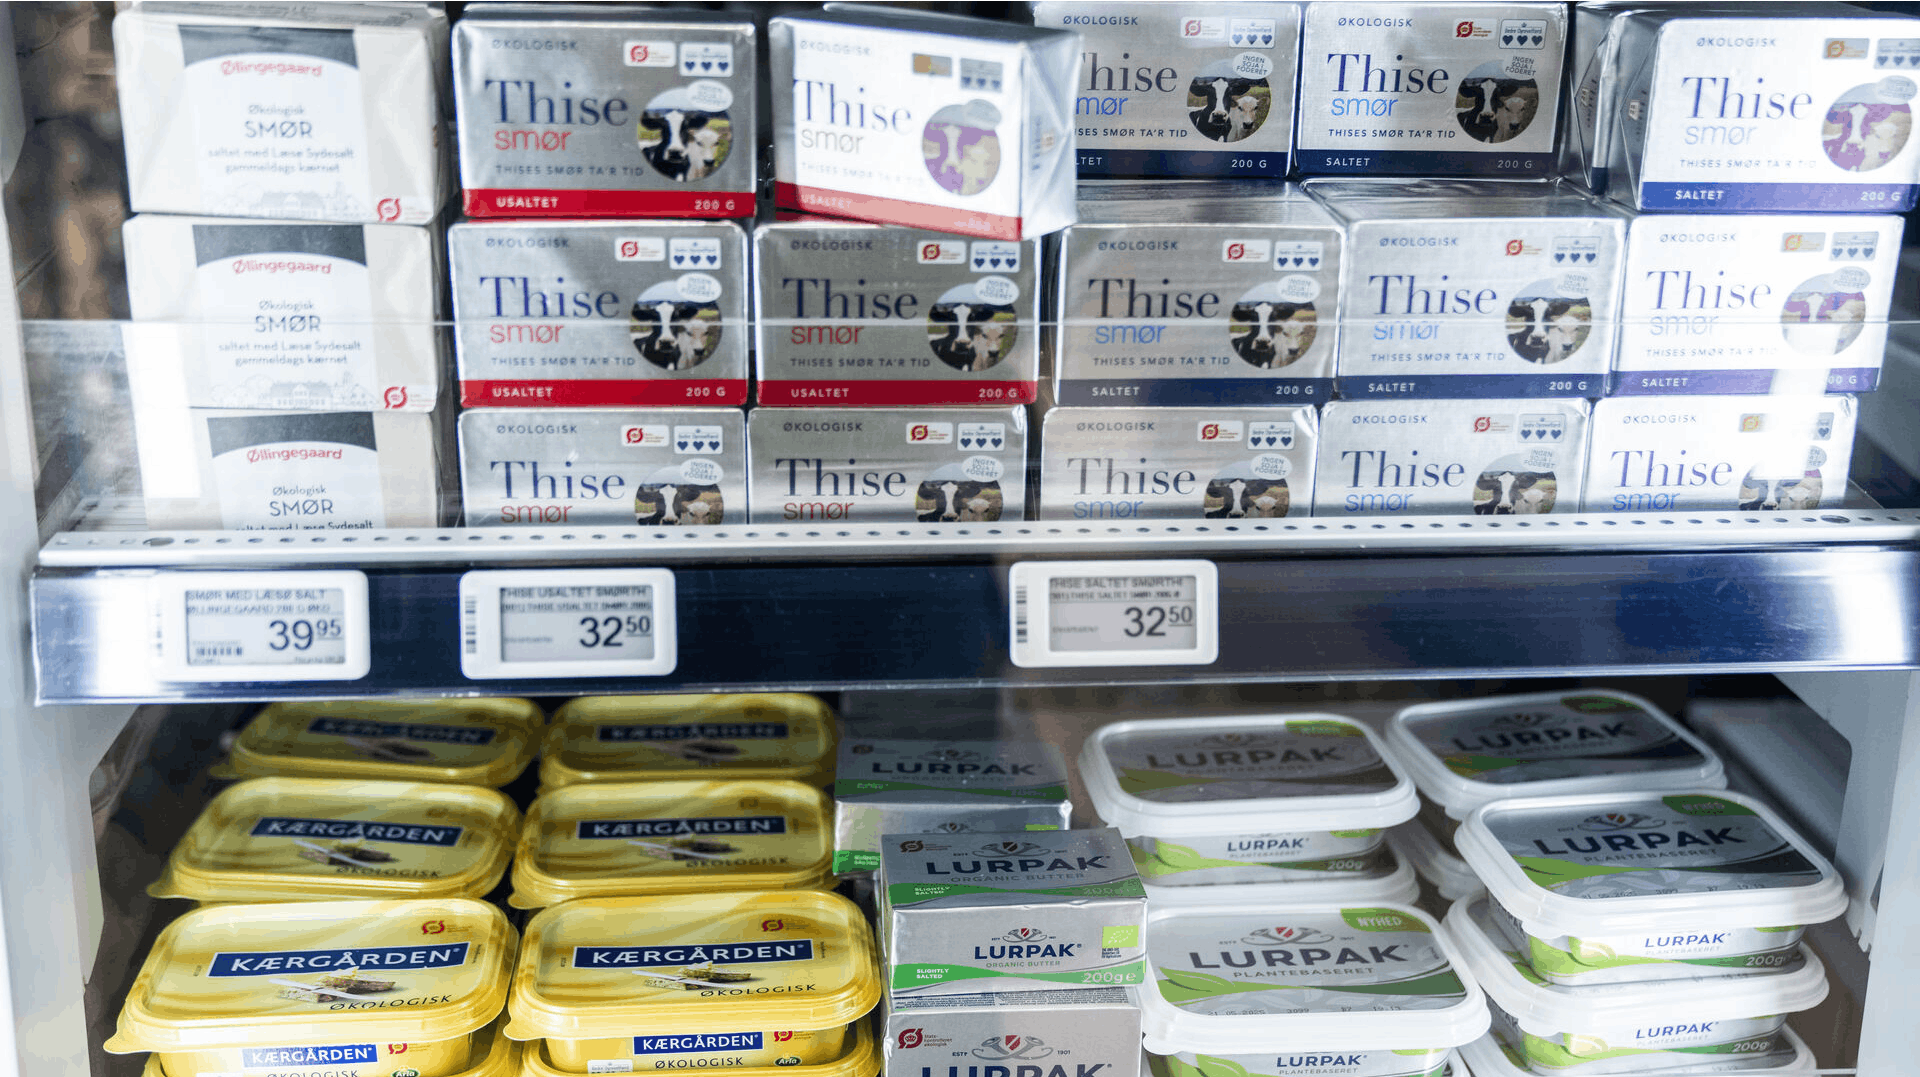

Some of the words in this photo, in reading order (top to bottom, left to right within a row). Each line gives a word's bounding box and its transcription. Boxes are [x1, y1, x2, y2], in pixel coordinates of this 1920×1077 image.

[1063, 16, 1138, 25] ØKOLOGISK
[1338, 18, 1412, 27] ØKOLOGISK
[492, 39, 577, 51] ØKOLOGISK
[1696, 37, 1776, 47] ØKOLOGISK
[1082, 53, 1177, 92] hise
[1328, 53, 1448, 93] Thise
[485, 80, 628, 126] Thise
[1076, 97, 1128, 115] mør
[1331, 97, 1398, 116] smør
[1681, 77, 1812, 120] Thise
[792, 80, 911, 134] Thise
[245, 121, 312, 138] SMØR
[1103, 129, 1134, 137] SMØR
[1329, 129, 1367, 137] THISES
[1372, 130, 1403, 138] SMØR
[1409, 130, 1432, 138] TA'R
[1684, 125, 1757, 146] smør
[495, 129, 571, 150] smør
[801, 128, 863, 154] smør
[1076, 157, 1102, 165] LTET
[1232, 160, 1253, 168] 200
[1260, 160, 1267, 168] G
[1326, 157, 1370, 166] SALTET
[1497, 160, 1519, 168] 200
[1525, 160, 1532, 169] G
[496, 197, 558, 208] USALTET
[694, 200, 719, 210] 200
[726, 200, 734, 210] G
[1675, 190, 1723, 201] SALTET
[791, 240, 873, 250] ØKOLOGISK
[1098, 241, 1178, 250] ØKOLOGISK
[1379, 237, 1458, 247] ØKOLOGISK
[1660, 233, 1736, 242] ØKOLOGISK
[480, 277, 619, 319] Thise
[1088, 278, 1219, 318] Thise
[1368, 275, 1497, 315] Thise
[1647, 271, 1771, 309] Thise
[783, 278, 918, 319] Thise
[255, 315, 320, 332] SMØR
[490, 323, 564, 344] smør
[791, 325, 864, 344] smør
[1095, 324, 1166, 344] smør
[492, 357, 535, 366] THISES
[541, 357, 576, 366] SMØR
[583, 357, 609, 365] TA'R
[615, 356, 635, 365] TID
[790, 358, 833, 367] THISES
[839, 358, 873, 367] SMØR
[879, 358, 904, 367] TA'R
[911, 358, 930, 367] TID
[1094, 357, 1135, 365] THISES
[1140, 357, 1174, 365] SMØR
[1180, 357, 1205, 365] TA'R
[1211, 356, 1229, 365] TID
[1371, 353, 1411, 362] THISES
[1417, 353, 1450, 361] SMØR
[1456, 353, 1480, 361] TA'R
[1487, 353, 1504, 361] TID
[492, 387, 553, 397] USALTET
[686, 387, 709, 397] 200
[717, 387, 725, 396] G
[791, 388, 849, 397] USALTET
[979, 388, 1002, 398] 200
[1008, 388, 1017, 398] G
[1092, 387, 1139, 396] SALTET
[1276, 385, 1298, 394] 200
[1305, 385, 1313, 394] G
[1368, 383, 1415, 392] SALTET
[1549, 381, 1571, 390] 200
[1578, 381, 1587, 390] G
[783, 422, 862, 432] ØKOLOGISK
[1077, 422, 1154, 431] ØKOLOGISK
[1352, 415, 1427, 424] ØKOLOGISK
[1623, 415, 1696, 424] ØKOLOGISK
[497, 425, 577, 434] ØKOLOGISK
[247, 448, 342, 463] Øllingegaard
[1068, 458, 1195, 495] Thise
[1342, 450, 1464, 488] Thise
[1611, 450, 1732, 487] Thise
[490, 461, 625, 500] Thise
[776, 459, 906, 497] Thise
[273, 485, 326, 496] Økologisk
[270, 499, 333, 517] SMØR
[1073, 500, 1143, 519] smør
[1345, 493, 1413, 512] smør
[501, 505, 573, 523] smør
[784, 502, 853, 520] smør
[1124, 606, 1166, 637] 32
[1168, 606, 1193, 623] 50
[269, 620, 313, 651] 39
[317, 619, 342, 637] 95
[580, 616, 623, 647] 32
[626, 616, 650, 633] 50
[1452, 722, 1637, 751] LURPAK
[1147, 747, 1345, 768] LURPAK
[872, 762, 1036, 775] LURPAK
[267, 820, 445, 842] KÆRGÅRDEN
[593, 819, 770, 836] KÆRGÅRDEN
[1228, 838, 1305, 851] LURPAK
[1534, 828, 1746, 855] LURPAK
[926, 856, 1107, 874] LURPAK
[951, 875, 1020, 883] ORGANIC
[1357, 917, 1401, 926] NYHED
[1645, 933, 1726, 948] LURPAK
[593, 945, 796, 963] KÆRGÅRDEN
[974, 944, 1075, 960] LURPAK
[1189, 945, 1408, 969] LURPAK
[231, 948, 452, 973] KÆRGÅRDEN
[1746, 955, 1784, 966] 200g
[1083, 972, 1123, 983] 200g
[1233, 968, 1374, 978] PLANTEBASERET
[701, 984, 816, 997] ØKOLOGISK
[330, 995, 453, 1011] ØKOLOGISK
[1635, 1022, 1713, 1039] LURPAK
[643, 1034, 754, 1050] KÆRGÅRDEN
[1733, 1041, 1769, 1052] 200g
[252, 1048, 368, 1064] KÆRGÅRDEN
[655, 1057, 744, 1069] ØKOLOGISK
[778, 1057, 798, 1065] Arla
[1277, 1055, 1361, 1068] LURPAK
